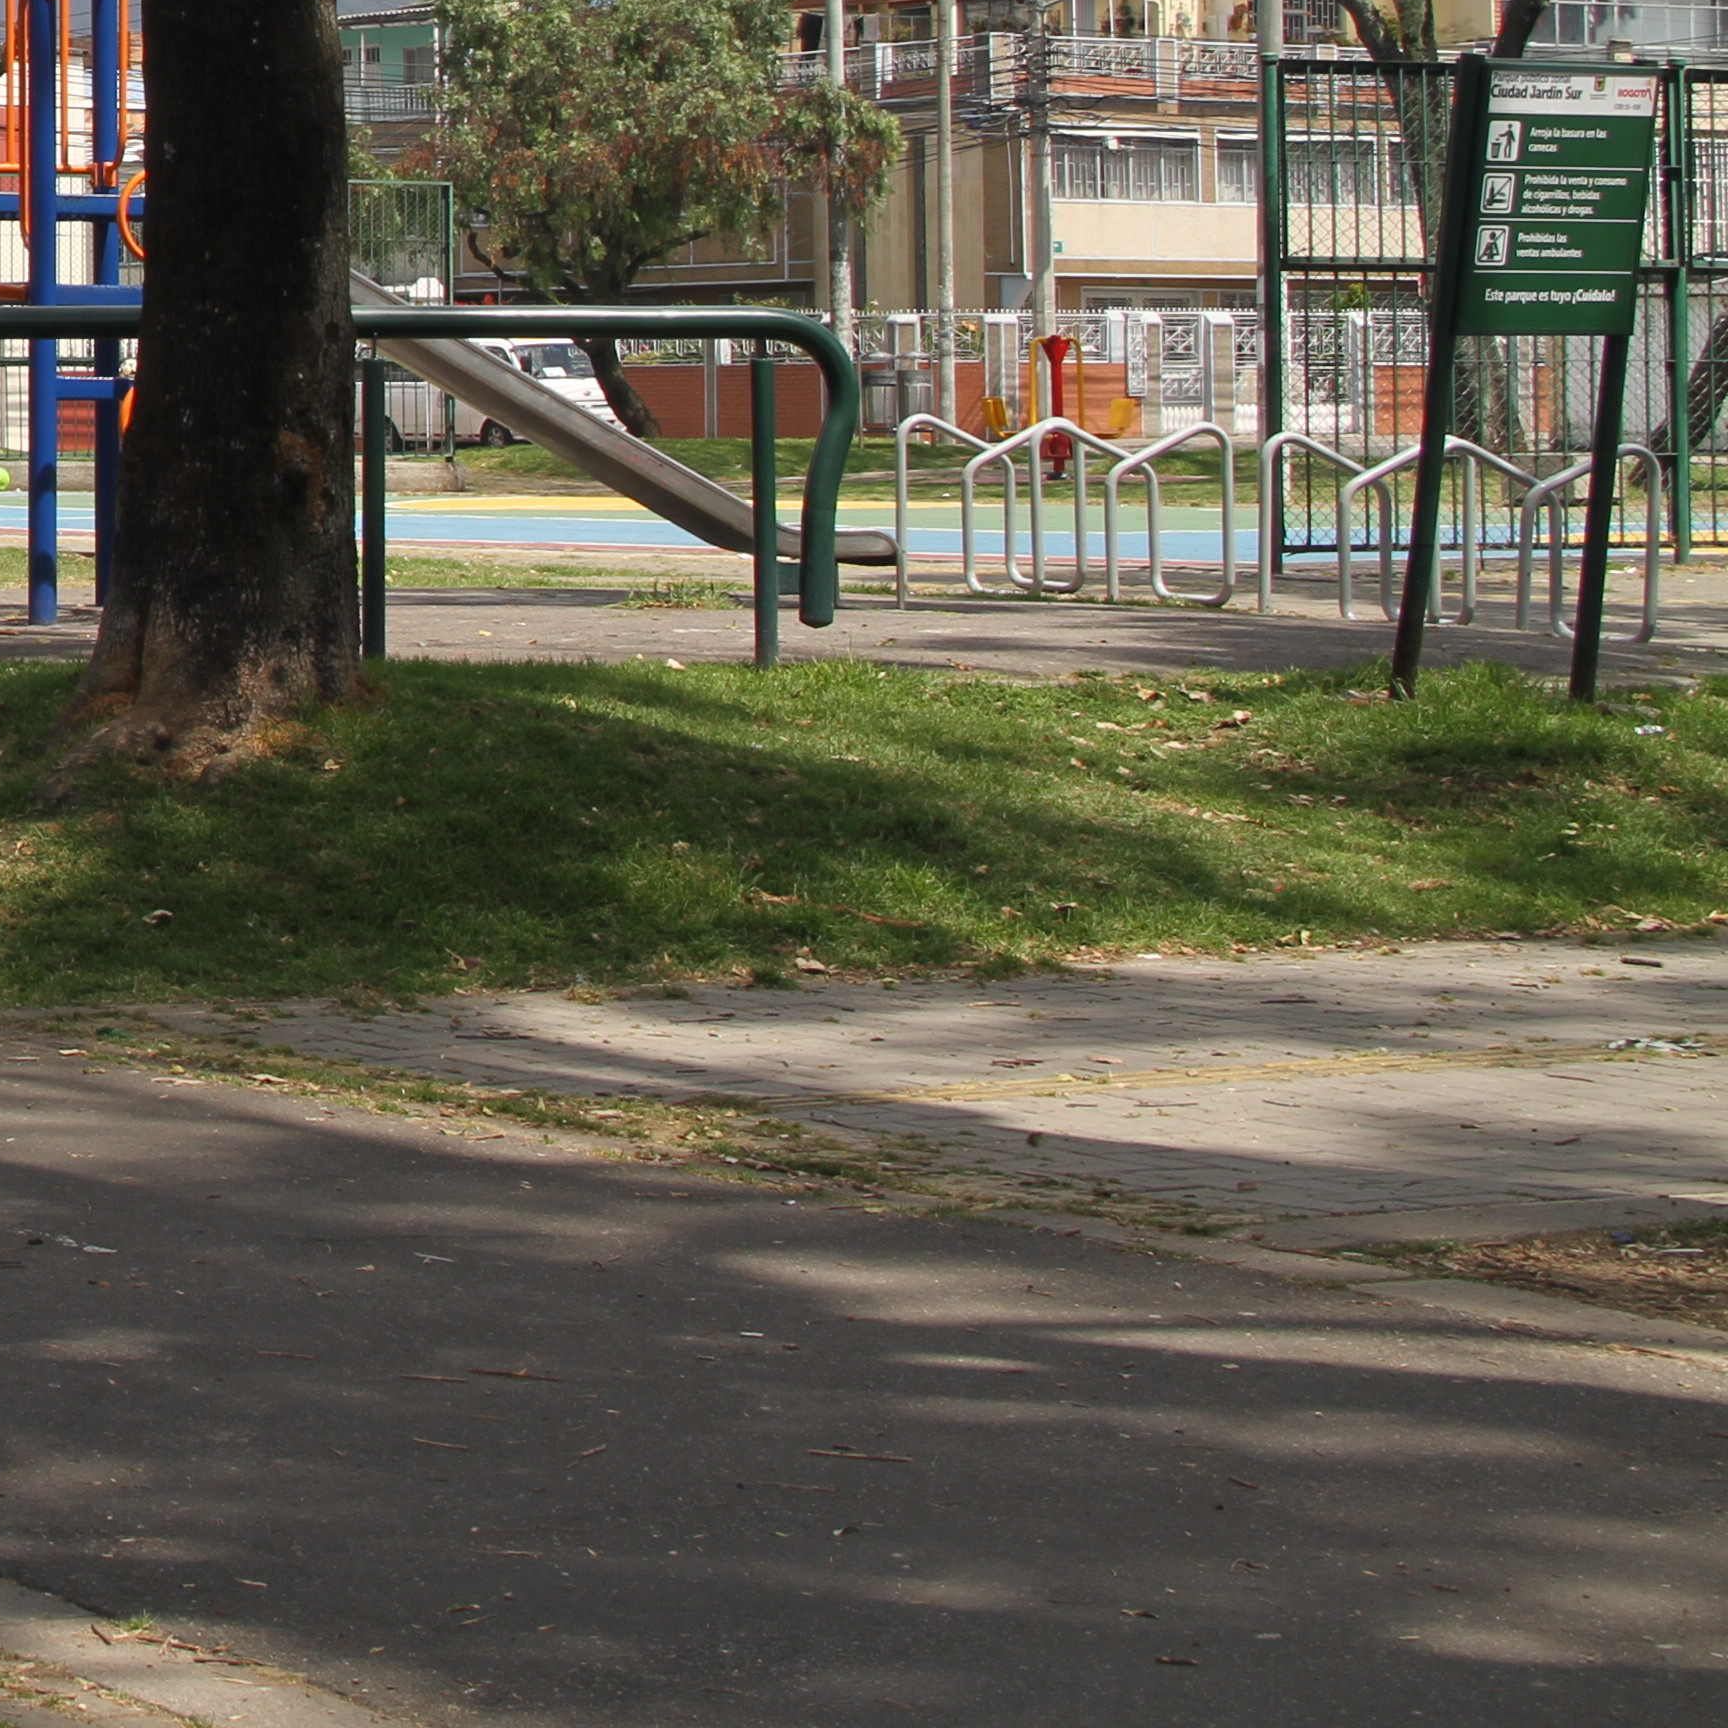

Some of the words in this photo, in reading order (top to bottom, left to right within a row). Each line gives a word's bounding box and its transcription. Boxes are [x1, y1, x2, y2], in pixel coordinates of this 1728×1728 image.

[1491, 84, 1527, 98] Ciudad
[1564, 86, 1583, 100] Sur
[1529, 127, 1552, 140] Arroja
[1553, 127, 1560, 138] la
[1561, 127, 1585, 138] basura
[1586, 130, 1595, 138] en
[1596, 128, 1607, 139] las
[1528, 143, 1558, 152] canecas
[1524, 174, 1559, 185] Prohibida
[1560, 175, 1567, 185] la
[1568, 176, 1588, 185] venta
[1588, 177, 1593, 187] y
[1594, 177, 1627, 186] consumo
[1522, 189, 1532, 200] de
[1572, 190, 1600, 200] bebidas
[1561, 206, 1567, 216] y
[1517, 232, 1556, 243] Prohibidas
[1557, 233, 1568, 244] las
[1516, 248, 1540, 258] ventas
[1540, 247, 1583, 258] ambulantes
[1485, 288, 1504, 302] Este
[1504, 291, 1537, 304] parque
[1538, 291, 1549, 302] es
[1550, 289, 1571, 304] tuyo
